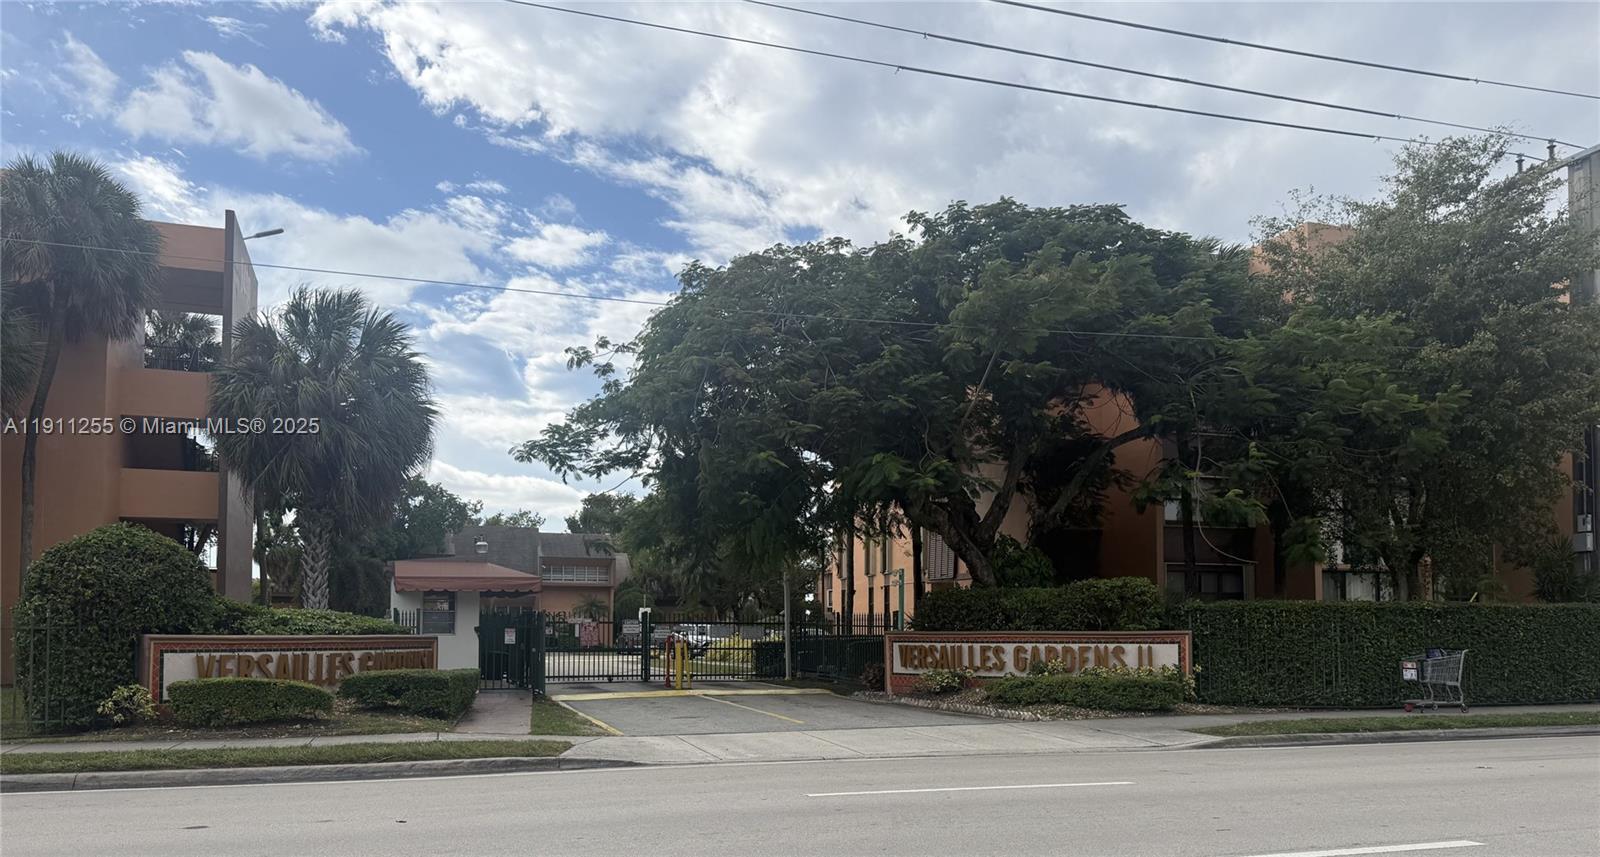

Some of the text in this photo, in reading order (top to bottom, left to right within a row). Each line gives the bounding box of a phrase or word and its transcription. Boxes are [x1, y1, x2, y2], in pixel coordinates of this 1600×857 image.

[195, 652, 355, 686] VERSAILLES
[898, 644, 1006, 671] VERSAILLES
[1013, 645, 1128, 673] GARDENS
